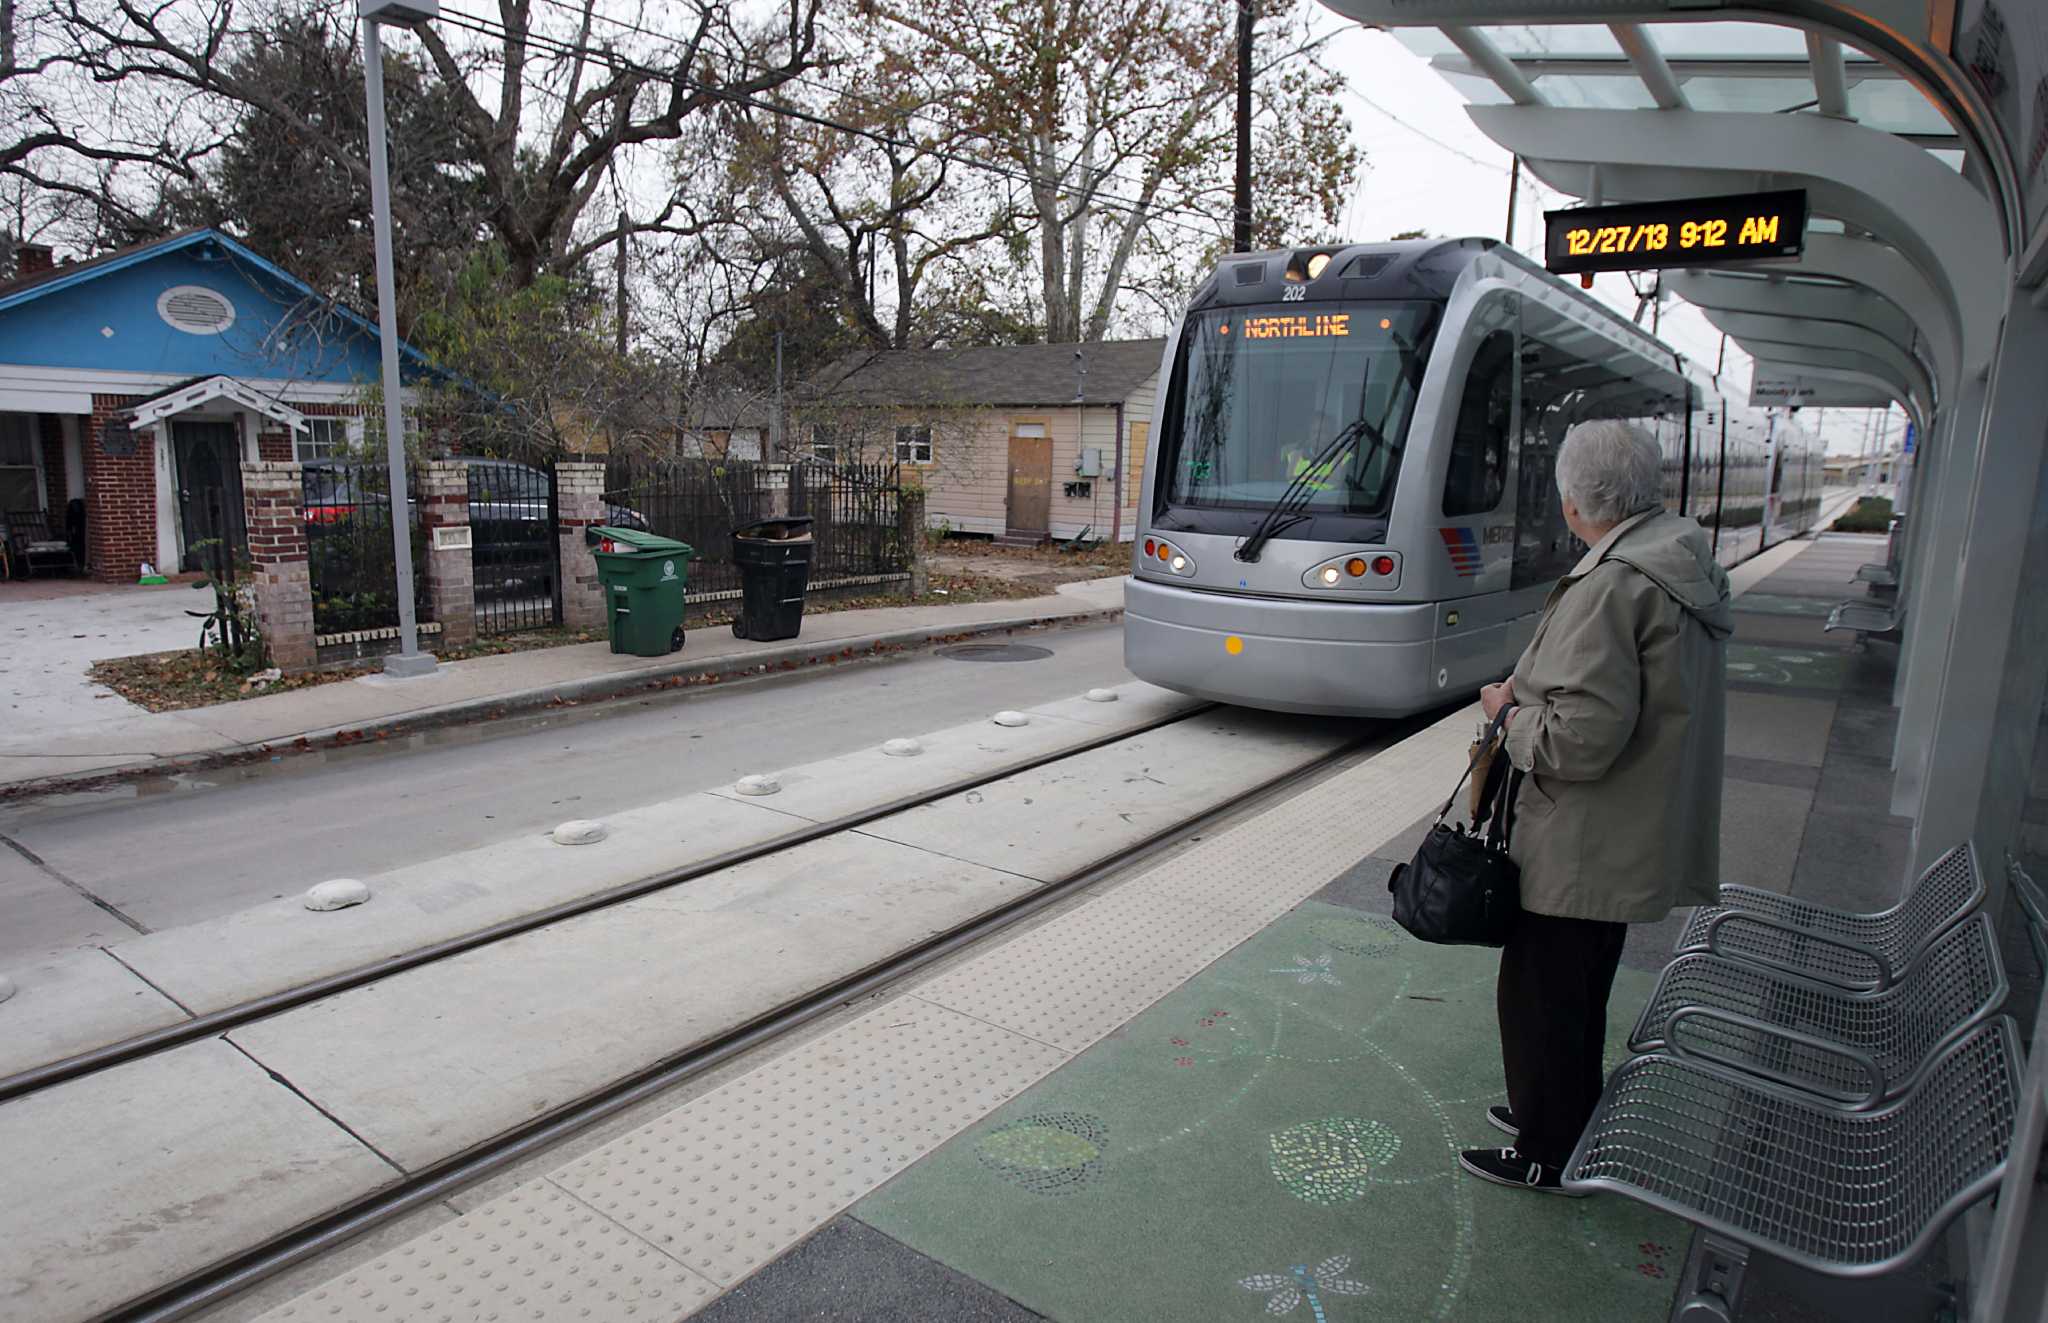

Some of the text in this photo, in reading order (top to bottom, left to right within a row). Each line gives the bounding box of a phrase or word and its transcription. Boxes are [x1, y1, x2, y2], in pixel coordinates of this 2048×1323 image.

[1566, 216, 1779, 256] 12/27/13 9:12 AM
[1282, 286, 1307, 302] 202
[1245, 313, 1350, 339] NORTHLINE
